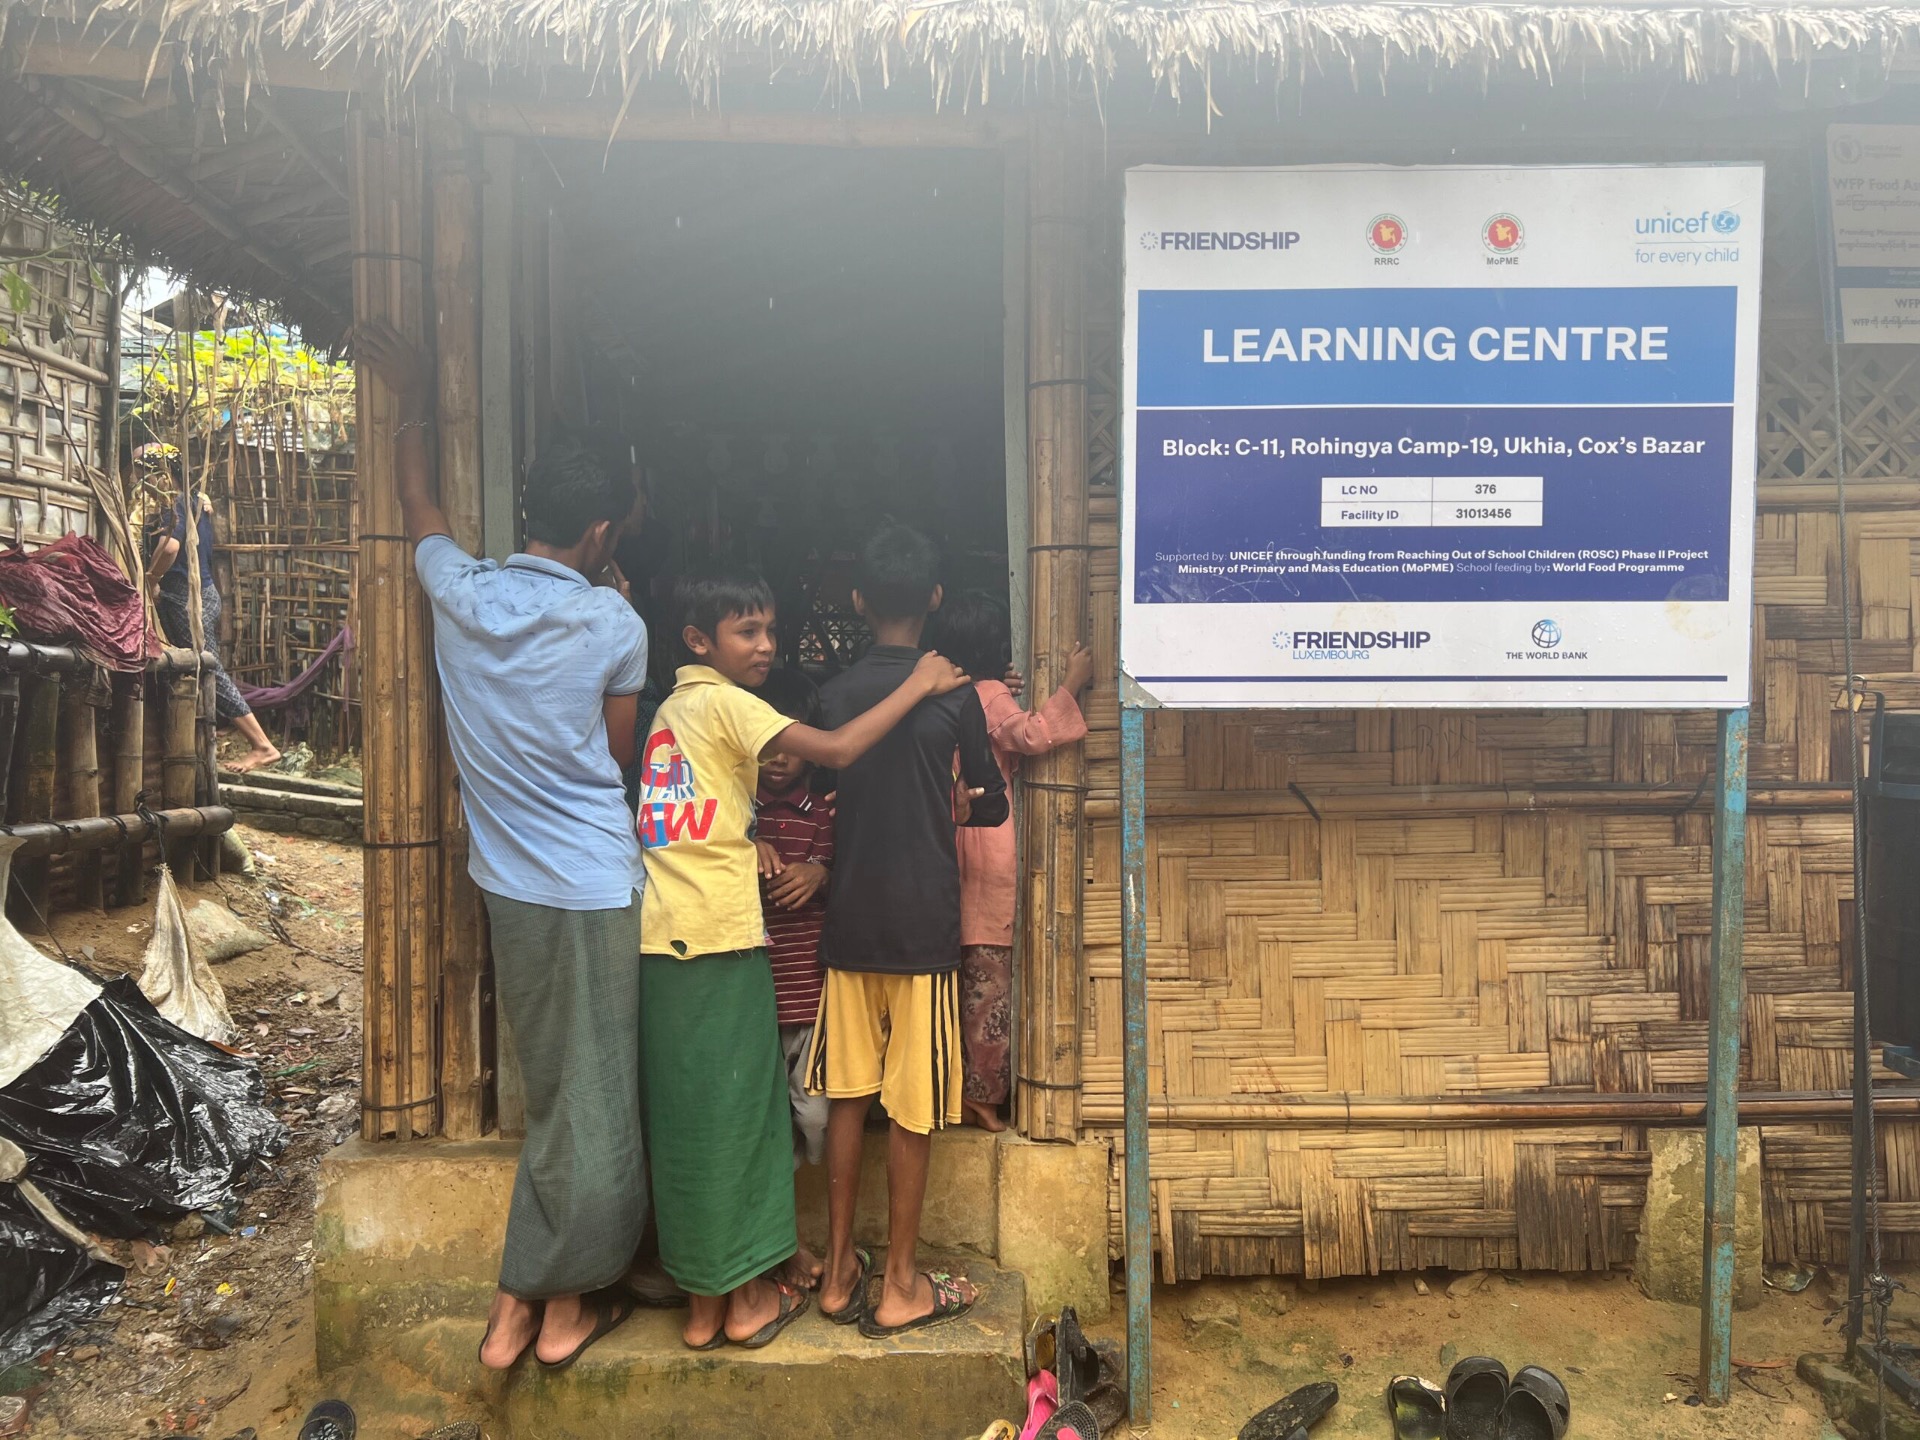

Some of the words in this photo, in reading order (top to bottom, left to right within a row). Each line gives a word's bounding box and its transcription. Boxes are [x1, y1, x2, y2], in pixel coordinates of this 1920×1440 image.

[1636, 211, 1709, 234] unicef
[1161, 231, 1300, 250] FRIENDSHIP
[1374, 257, 1400, 266] RRRC
[1486, 256, 1519, 265] MoPME
[1635, 248, 1656, 263] for
[1659, 251, 1702, 266] every
[1704, 248, 1739, 262] child
[1203, 327, 1456, 363] LEARNING
[1469, 326, 1668, 361] CENTRE
[1163, 439, 1229, 456] Block:
[1235, 438, 1285, 458] C-11,
[1291, 437, 1392, 458] Rohingya
[1398, 437, 1498, 458] Camp-19,
[1504, 437, 1572, 457] Ukhia,
[1643, 437, 1706, 454] Bazar
[1342, 485, 1357, 495] LC
[1360, 485, 1378, 495] NO
[1475, 484, 1496, 494] 376
[1341, 510, 1384, 522] Facility
[1386, 510, 1399, 519] ID
[1456, 508, 1512, 519] 31013456
[1155, 552, 1209, 563] Supported
[1211, 551, 1227, 563] by:
[1230, 551, 1273, 561] UNICEF
[1275, 550, 1321, 562] through
[1322, 550, 1366, 562] funding
[1368, 550, 1394, 559] from
[1397, 550, 1449, 561] Reaching
[1452, 550, 1472, 559] Out
[1474, 550, 1486, 559] of
[1488, 550, 1526, 559] School
[1528, 550, 1575, 559] Children
[1578, 550, 1619, 560] (ROSC)
[1622, 550, 1656, 559] Phase
[1658, 550, 1665, 559] II
[1668, 550, 1708, 560] Project
[1178, 564, 1225, 576] Ministry
[1227, 564, 1238, 573] of
[1240, 564, 1286, 575] Primary
[1288, 564, 1309, 573] and
[1311, 564, 1340, 573] Mass
[1343, 563, 1399, 572] Education
[1402, 563, 1454, 573] (MoPME)
[1457, 563, 1492, 571] School
[1495, 563, 1532, 573] feeding
[1535, 563, 1550, 573] by:
[1552, 562, 1586, 572] World
[1588, 562, 1616, 572] Food
[1618, 563, 1685, 573] Programme
[1292, 631, 1431, 649] FRIENDSHIP
[1292, 650, 1370, 660] LUXEMBOURG
